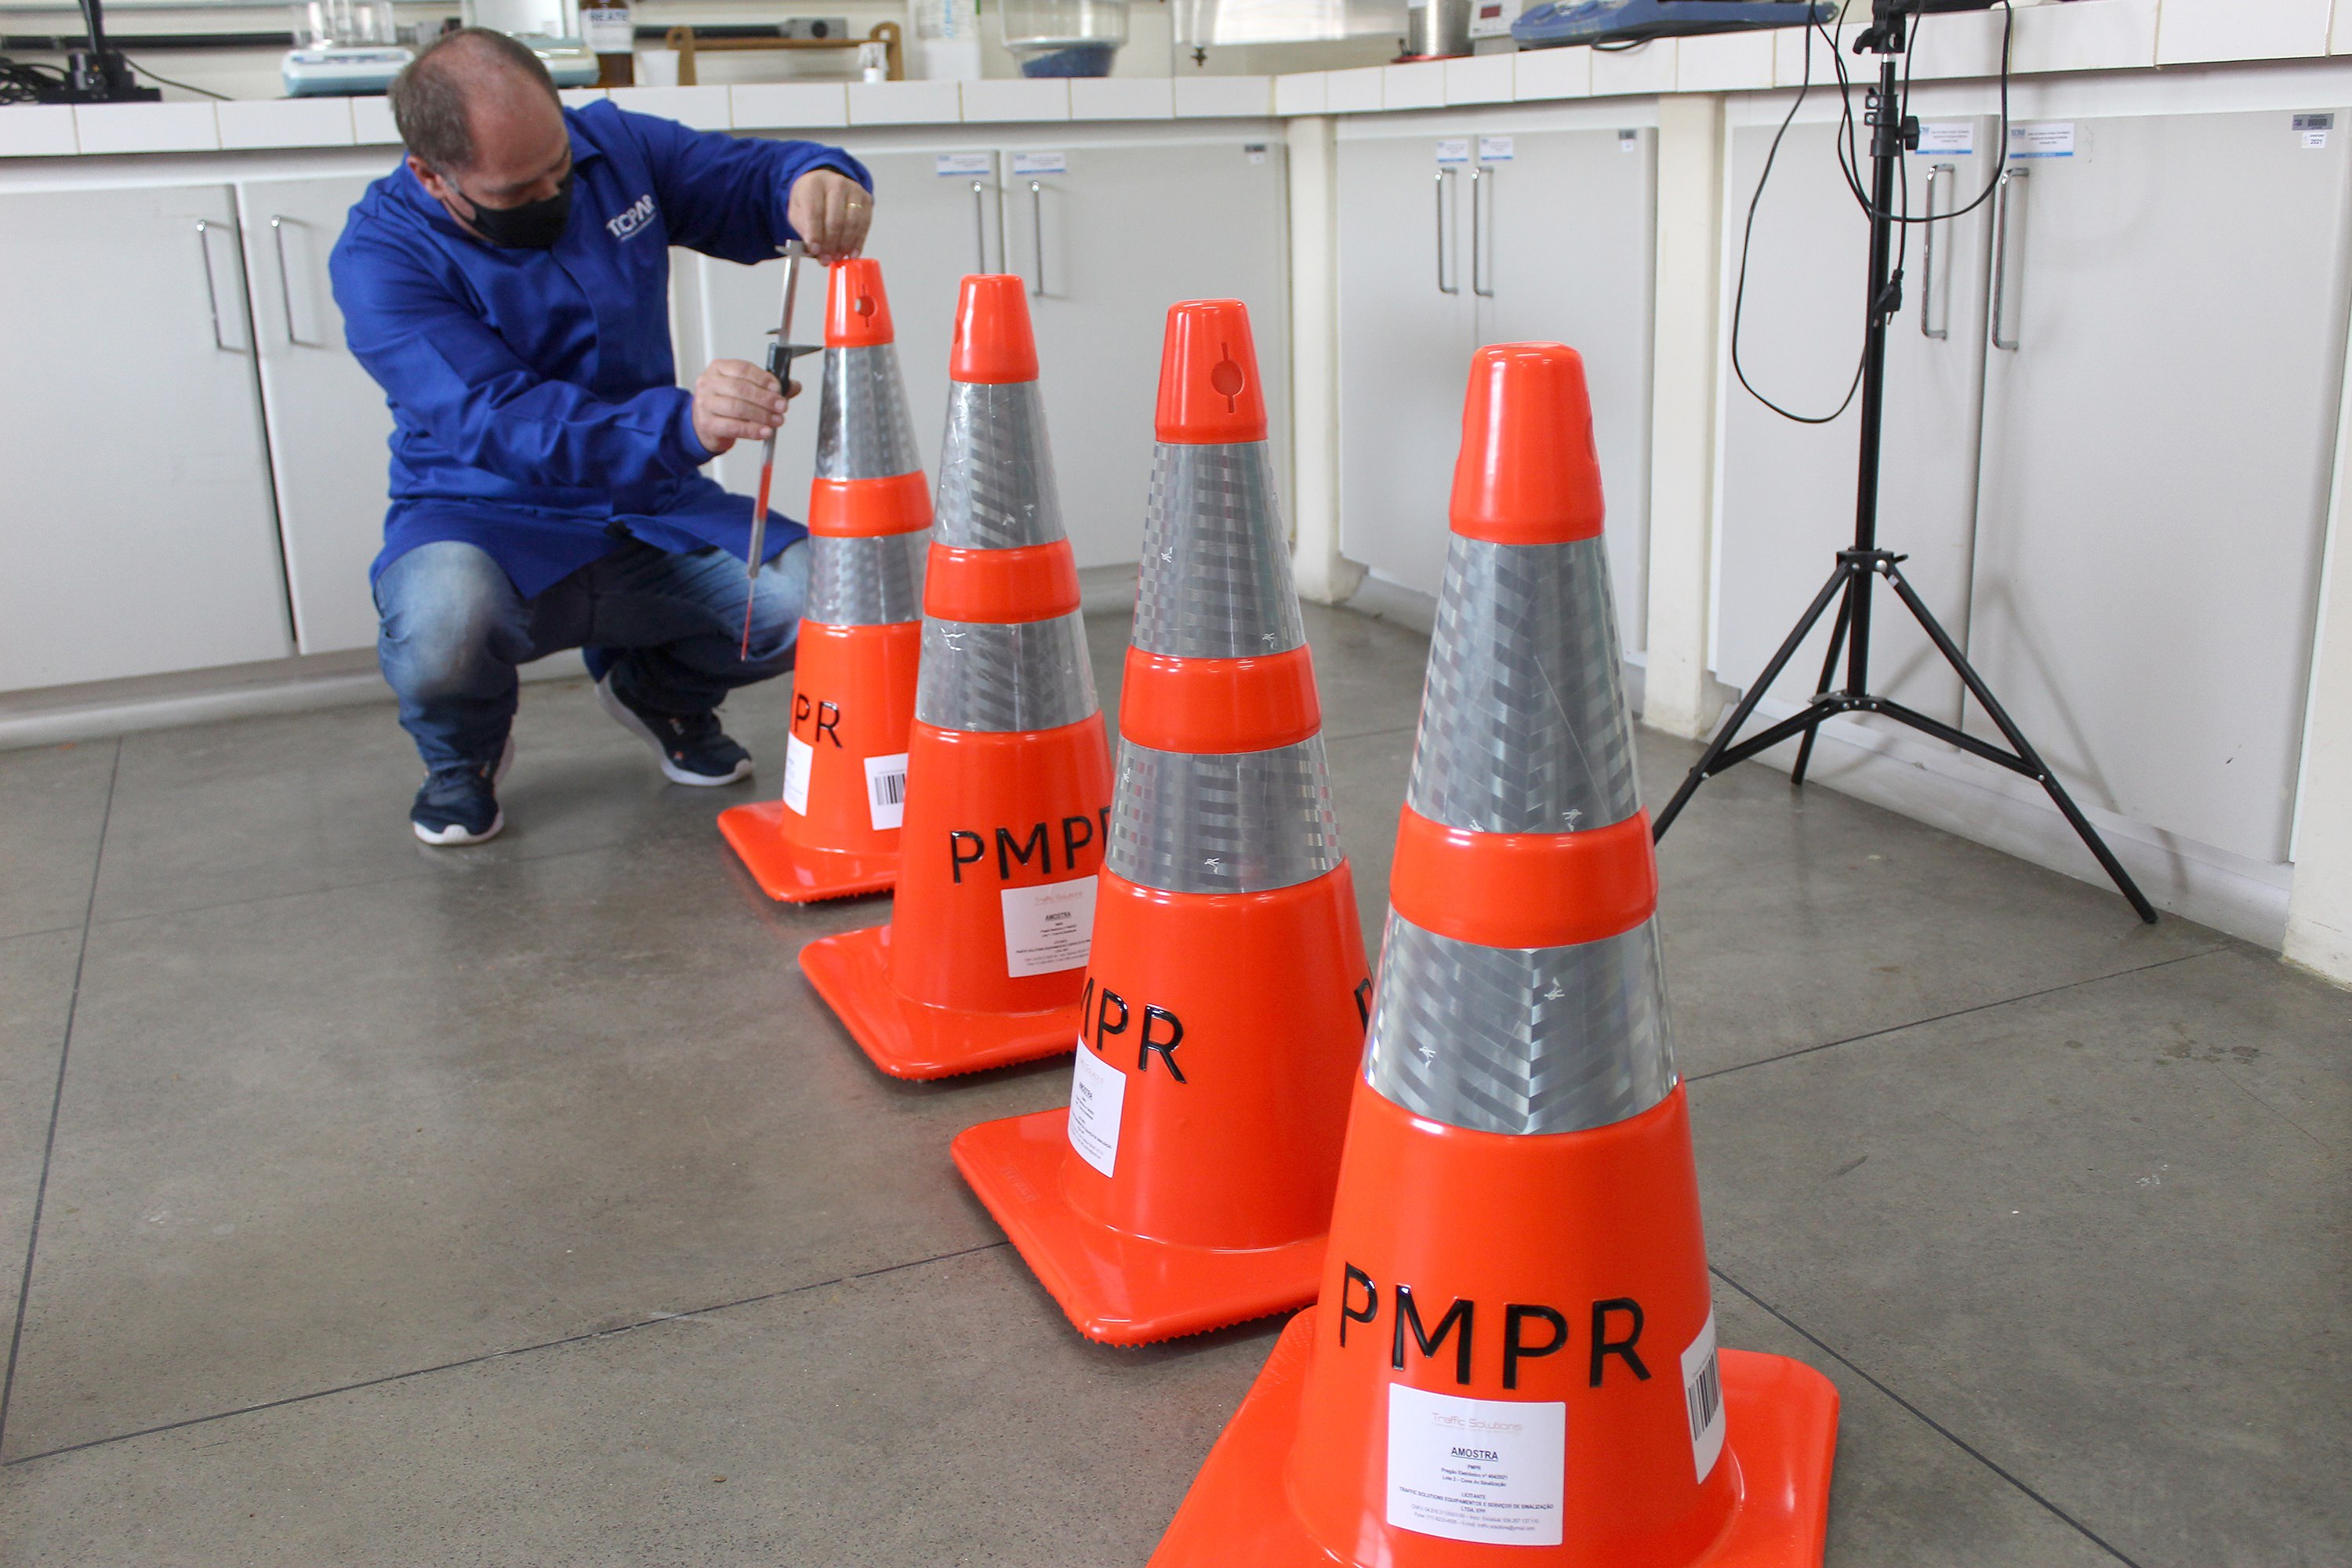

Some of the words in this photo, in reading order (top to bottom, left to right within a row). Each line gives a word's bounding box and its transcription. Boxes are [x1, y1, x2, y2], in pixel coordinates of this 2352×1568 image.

[1340, 1261, 1651, 1390] PMPR
[1432, 1412, 1465, 1427] Traffic
[1468, 1418, 1523, 1432] Solutions
[1451, 1446, 1499, 1461] AMOSTRA
[1399, 1486, 1417, 1496] TRAFFIC
[1417, 1490, 1444, 1501] SOLUTIONS
[1445, 1496, 1482, 1507] EQUIPAMENTOS
